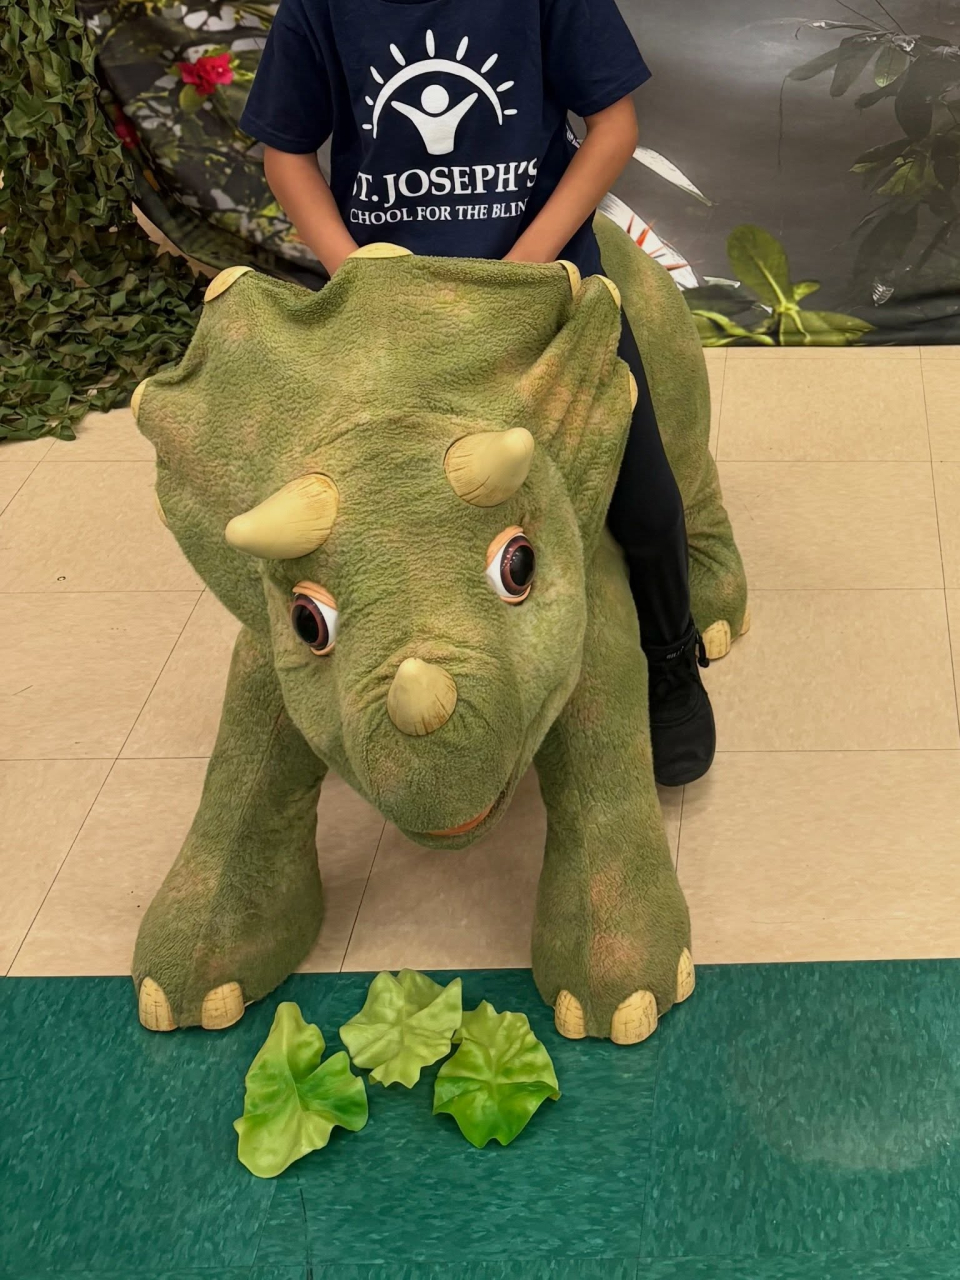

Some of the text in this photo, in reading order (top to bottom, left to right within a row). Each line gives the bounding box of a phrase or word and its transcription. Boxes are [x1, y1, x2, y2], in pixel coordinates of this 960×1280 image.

[352, 157, 538, 208] T. JOSEPH'S
[350, 197, 529, 225] CHOOL FOR THE BLIN
